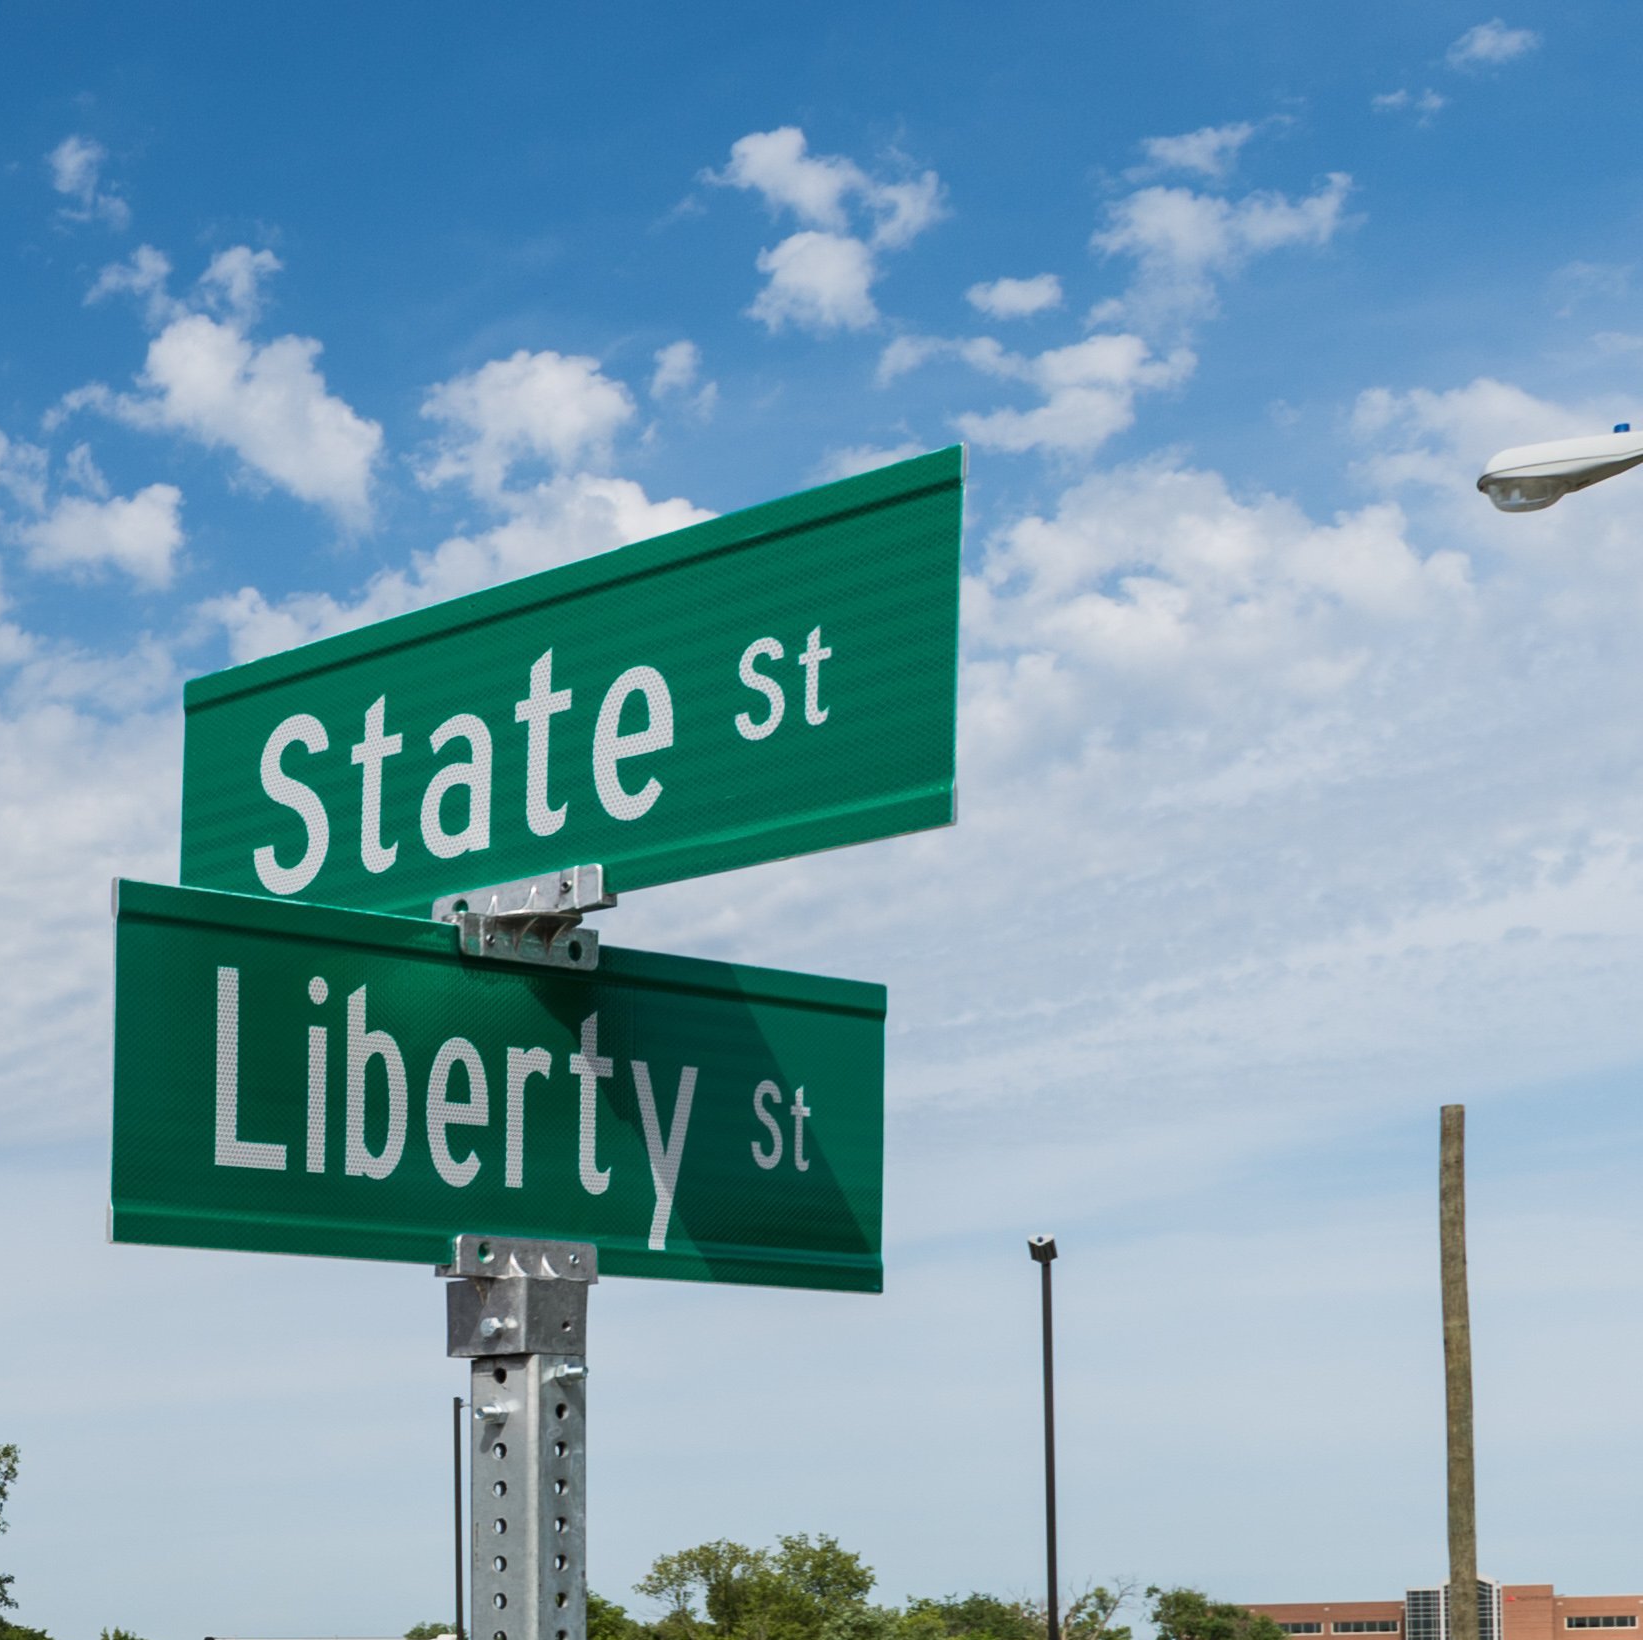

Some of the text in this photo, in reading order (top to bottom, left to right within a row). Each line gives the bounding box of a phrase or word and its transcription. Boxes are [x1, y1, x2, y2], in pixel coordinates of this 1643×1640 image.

[252, 624, 833, 896] State St
[214, 965, 812, 1251] Liberty St
